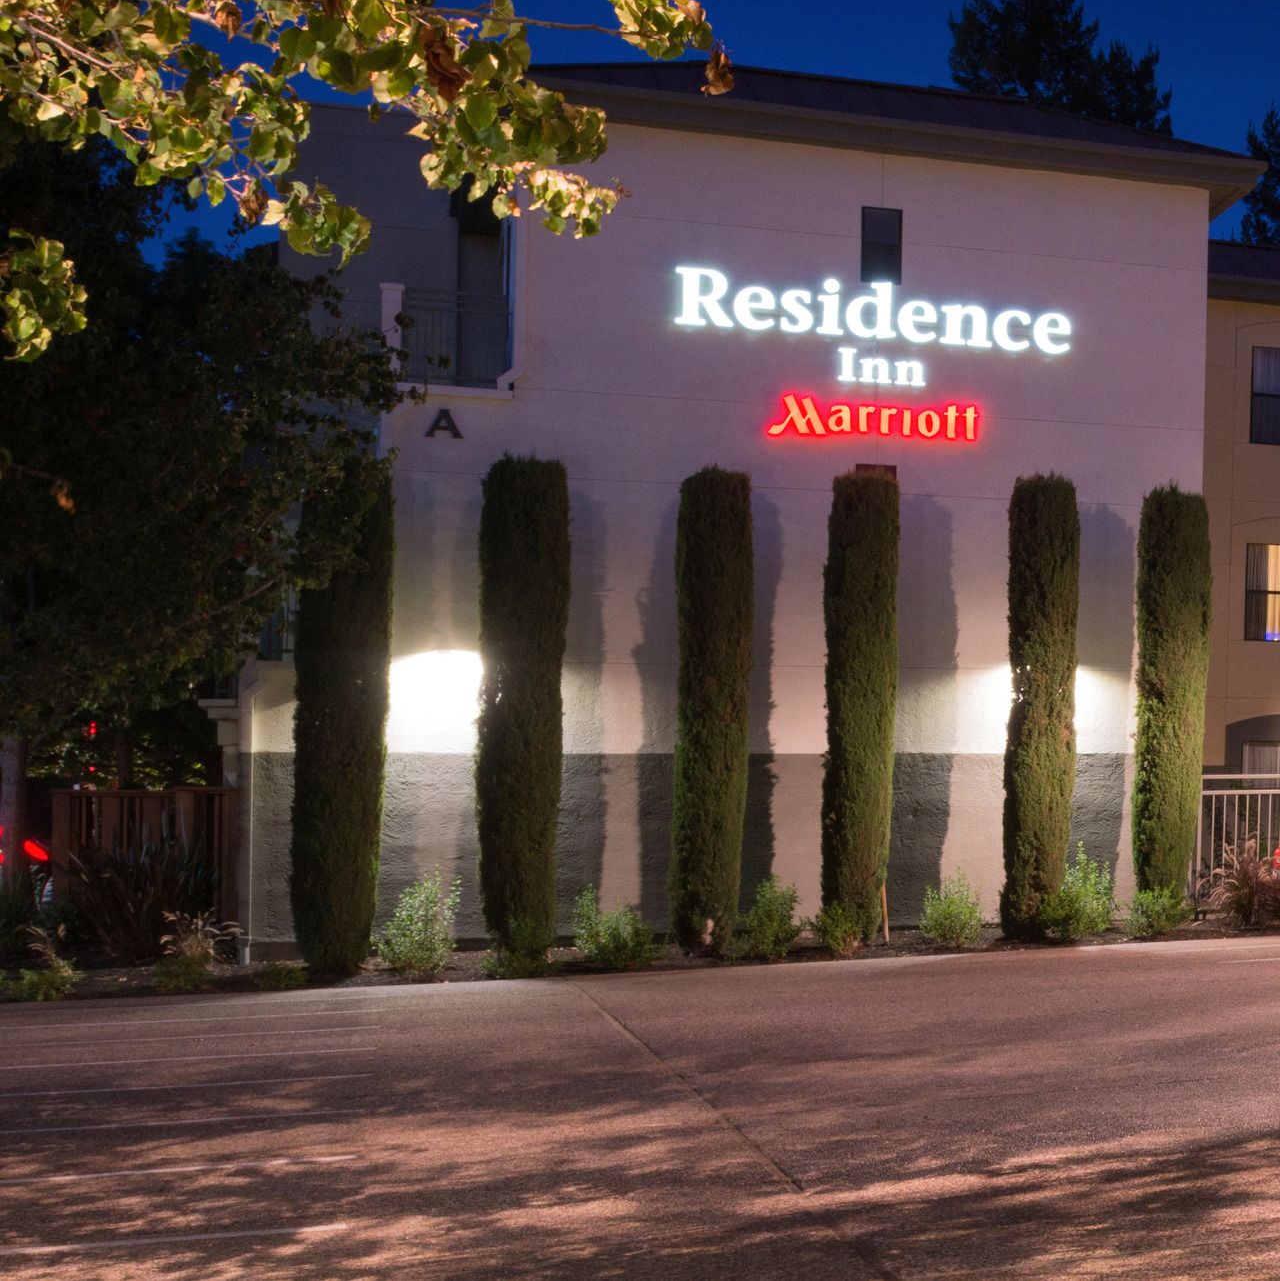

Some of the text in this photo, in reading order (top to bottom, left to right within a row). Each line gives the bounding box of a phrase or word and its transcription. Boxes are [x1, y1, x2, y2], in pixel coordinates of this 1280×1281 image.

[675, 267, 1071, 354] Residence
[838, 347, 926, 387] Inn
[425, 409, 464, 438] A
[768, 394, 979, 440] Marriott
